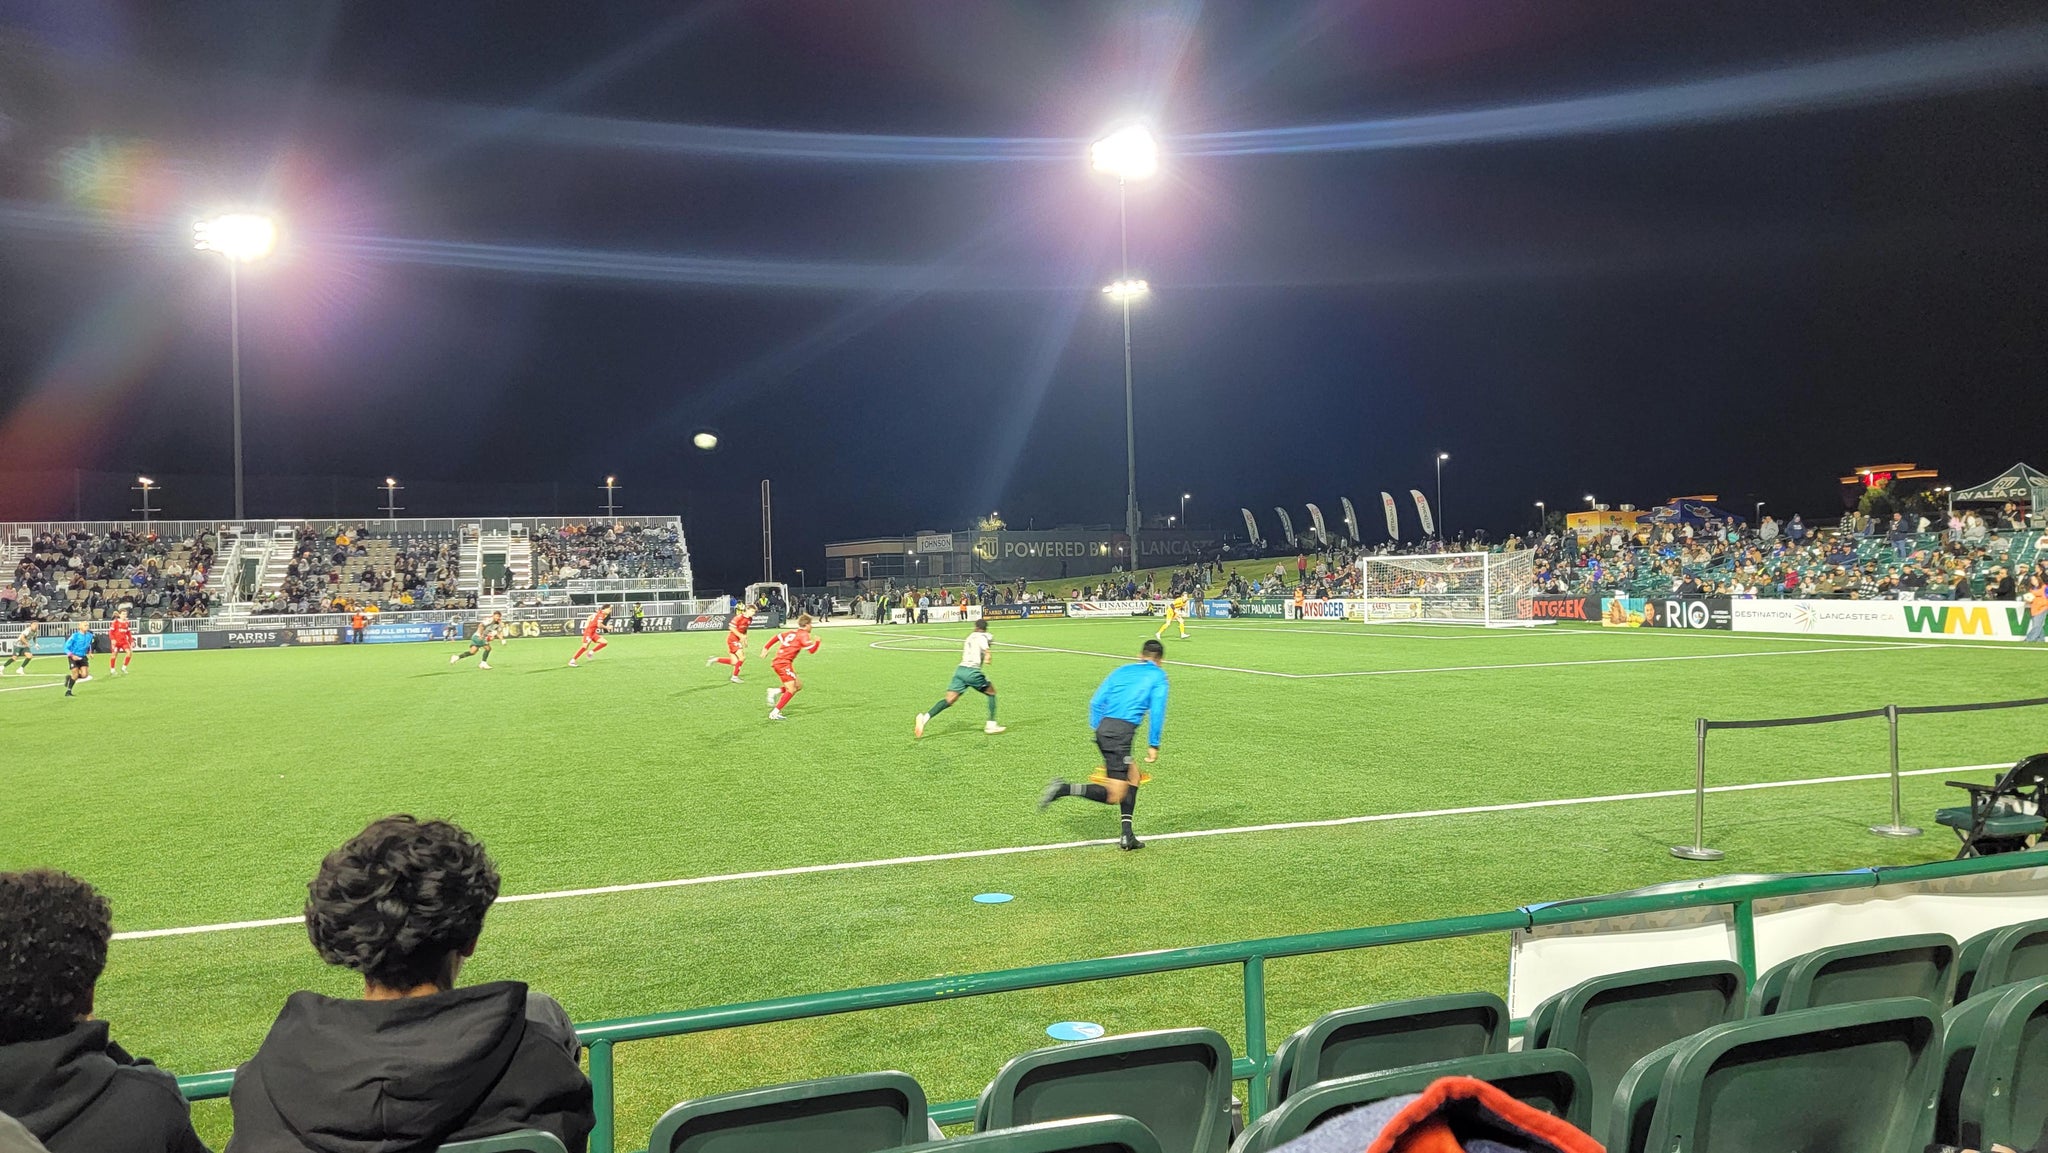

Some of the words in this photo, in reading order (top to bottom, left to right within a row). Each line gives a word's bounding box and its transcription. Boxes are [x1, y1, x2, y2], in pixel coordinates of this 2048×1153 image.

[1957, 492, 1974, 500] AV
[1974, 489, 2007, 499] ALTA
[2009, 488, 2027, 497] FC
[921, 538, 950, 551] JOHNSON
[1005, 541, 1085, 557] POWERED
[1251, 605, 1282, 614] PALMDALE
[1304, 602, 1344, 617] AYSOCCER
[1666, 600, 1709, 629] RIO
[1734, 610, 1792, 619] DESTINATION
[1819, 612, 1878, 620] LANCASTER
[580, 618, 631, 629] DERT
[641, 617, 672, 626] STAR
[696, 620, 723, 630] Collision
[1903, 605, 1993, 636] WM
[228, 632, 276, 640] PARRIS
